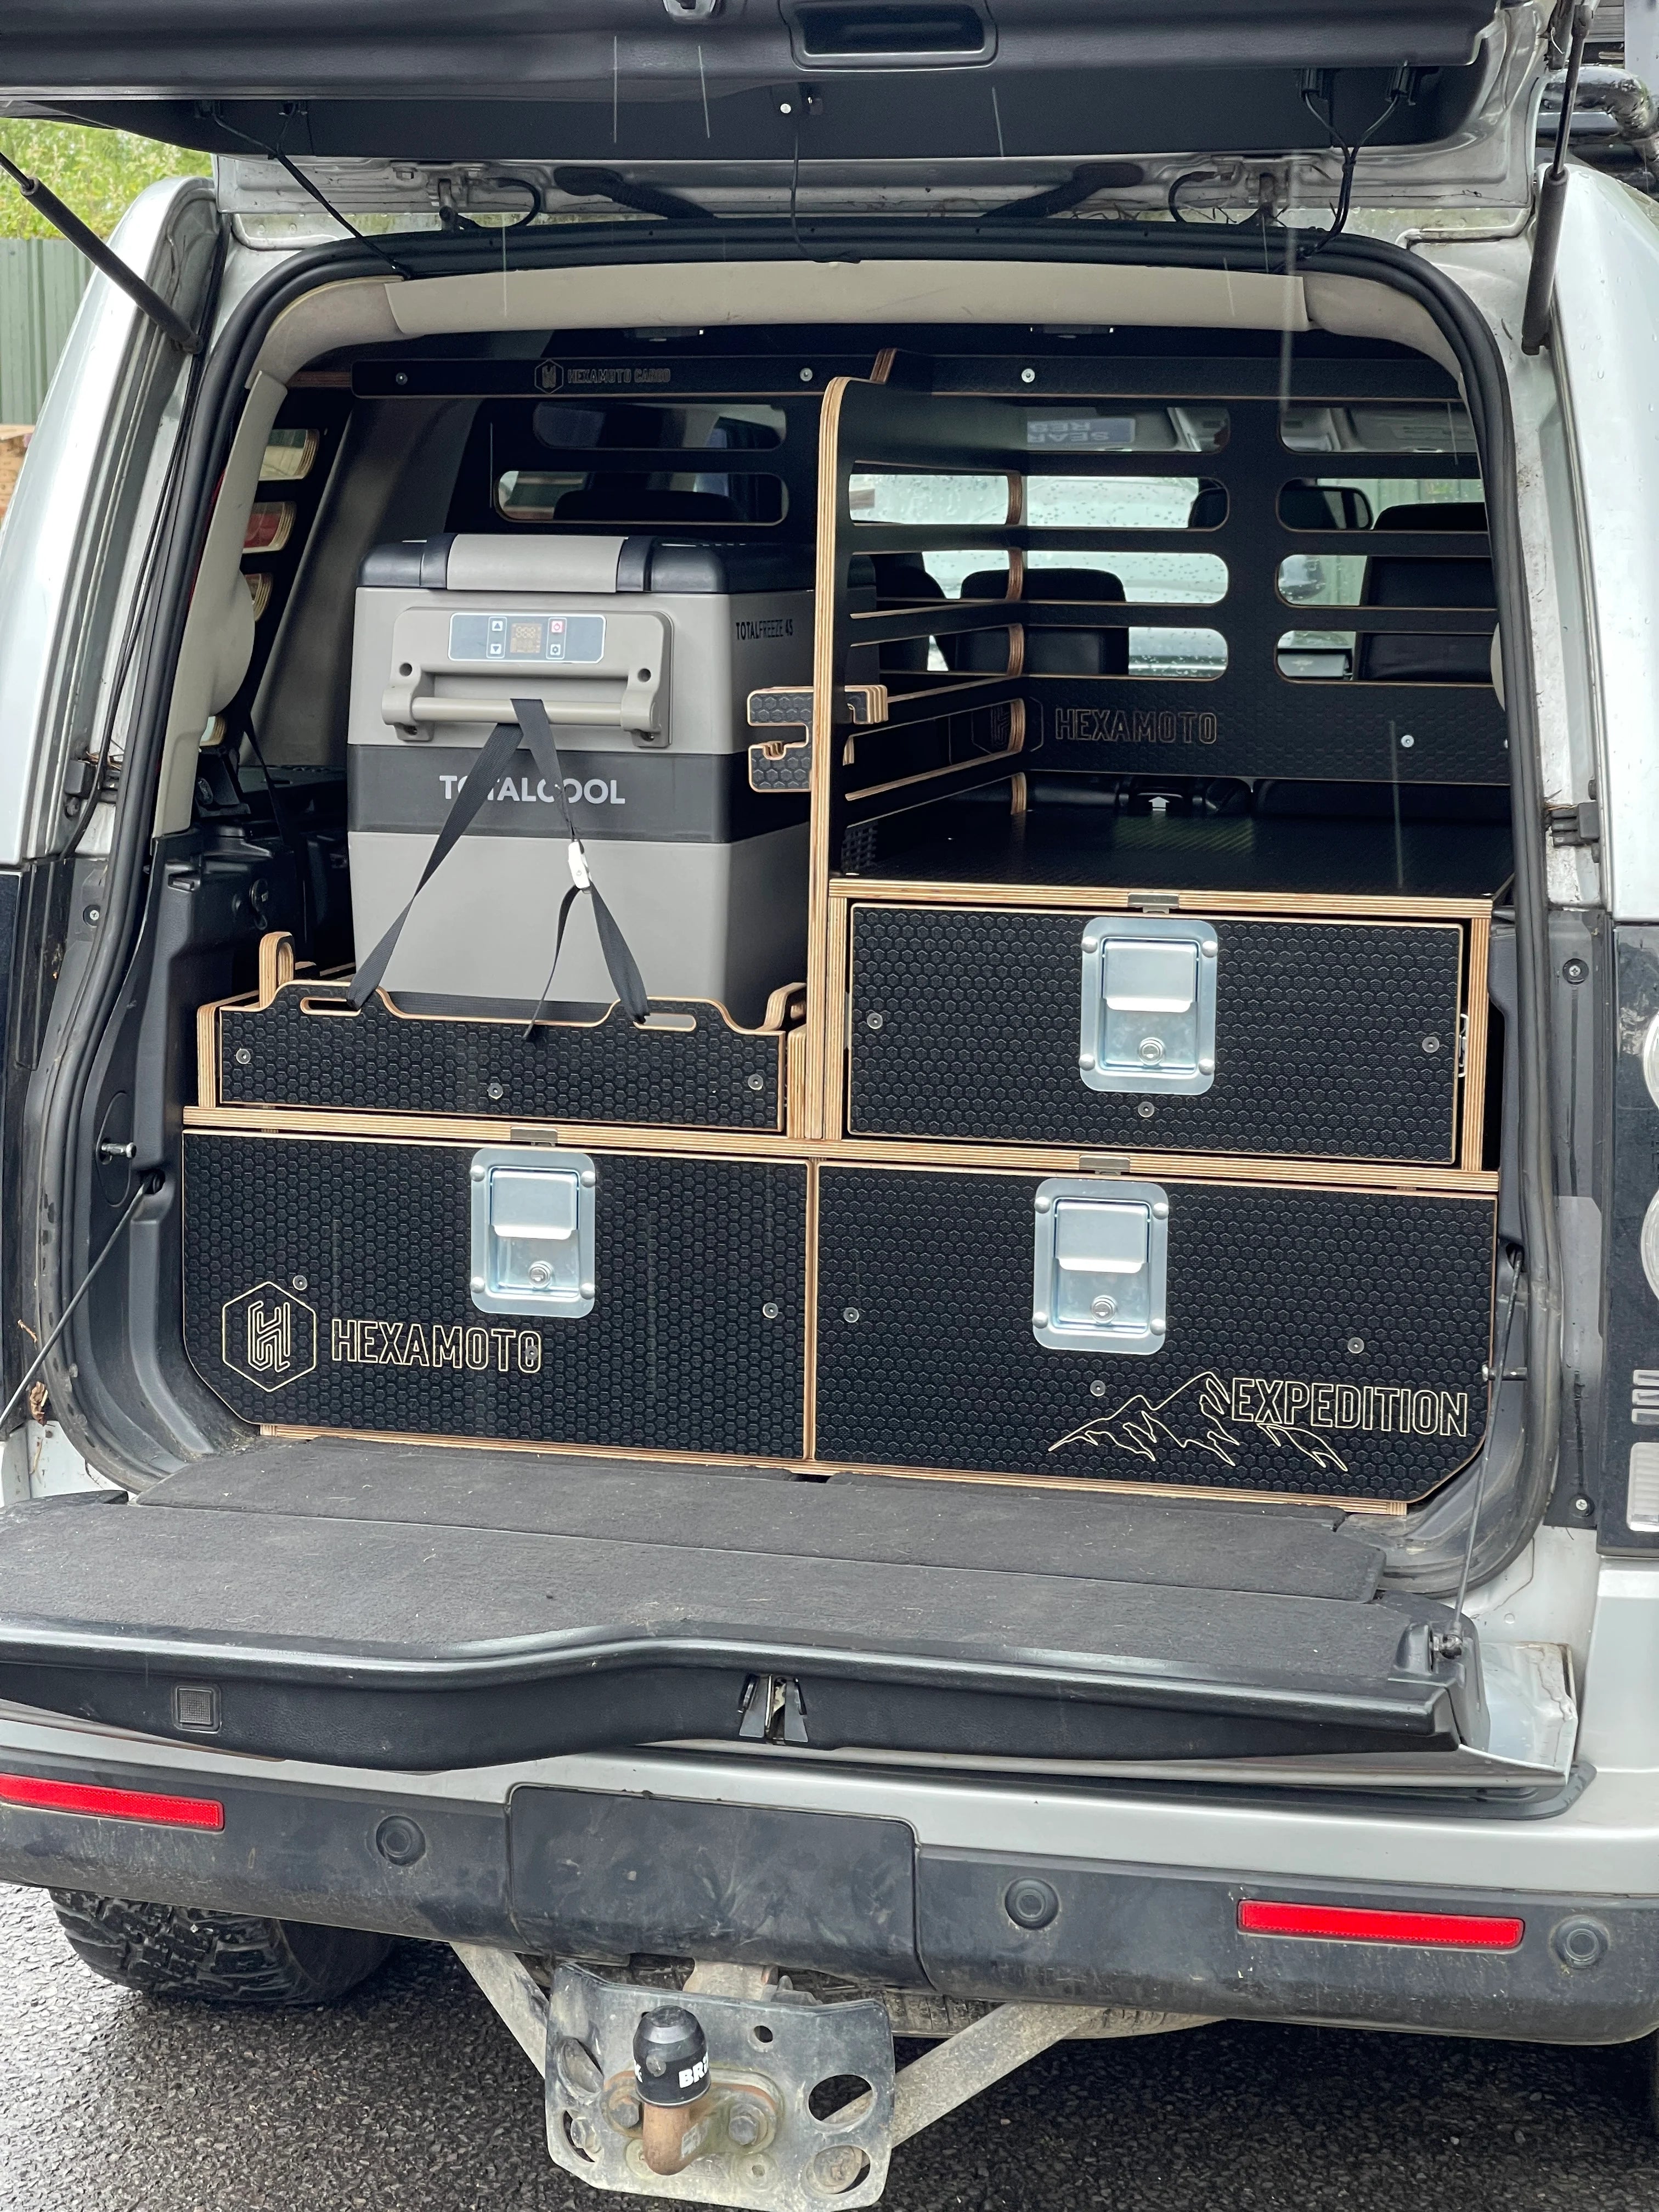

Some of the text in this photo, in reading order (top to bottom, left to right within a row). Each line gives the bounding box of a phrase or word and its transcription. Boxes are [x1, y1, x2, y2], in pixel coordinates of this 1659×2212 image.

[736, 619, 783, 640] TOTALFREEZE
[1055, 708, 1217, 744] HEXAMOTO
[439, 775, 626, 804] TALCOOL
[331, 1318, 541, 1374] HEXAMOTO
[1232, 1377, 1468, 1437] EXPEDITION
